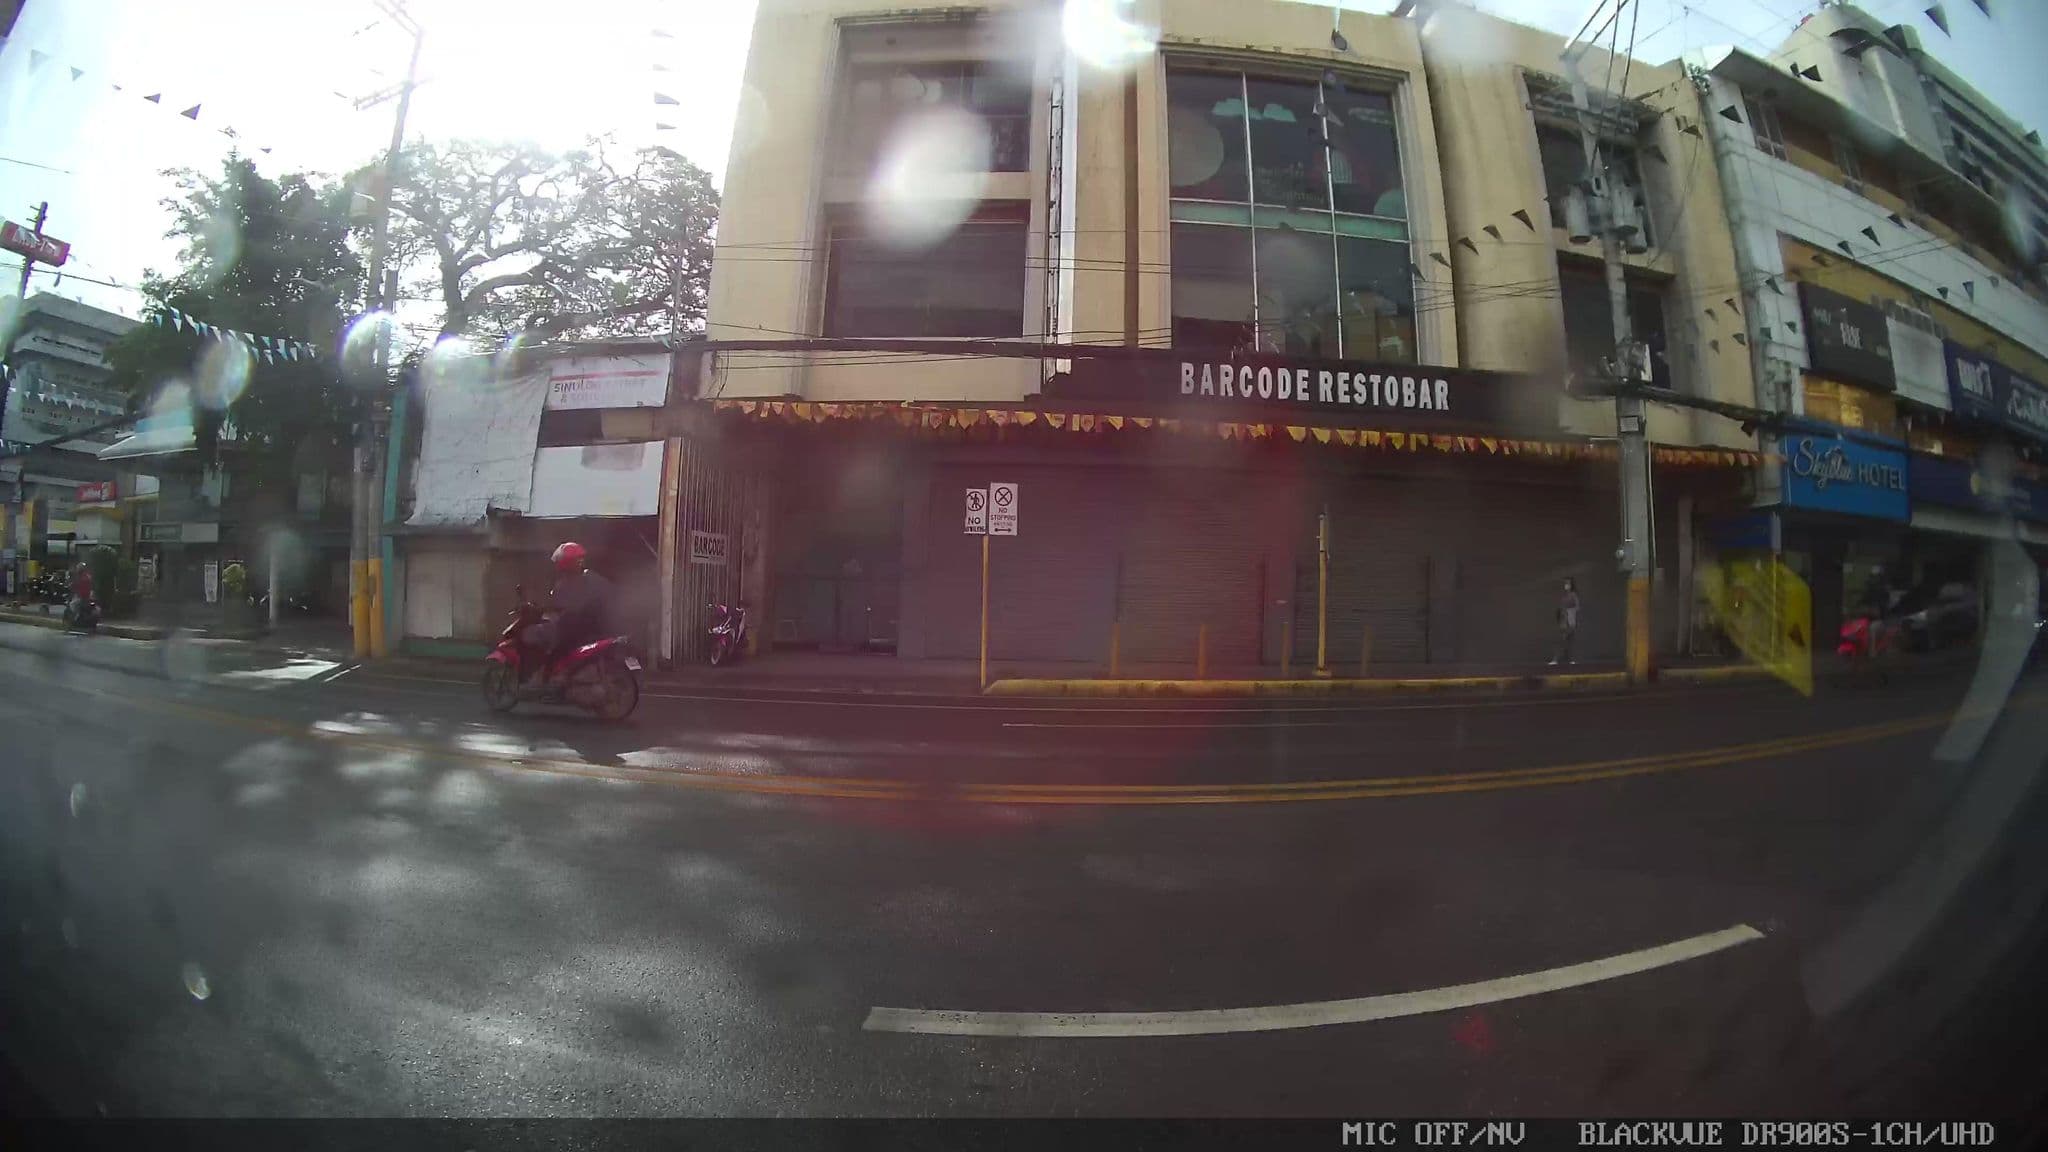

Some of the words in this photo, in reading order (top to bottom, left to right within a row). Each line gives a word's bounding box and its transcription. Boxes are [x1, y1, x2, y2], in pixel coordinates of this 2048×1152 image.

[1181, 362, 1310, 401] BARCODE
[1319, 370, 1450, 410] RESTOBAR
[1858, 463, 1906, 491] HOTEL
[967, 516, 981, 525] NO
[694, 535, 726, 557] BARCODE
